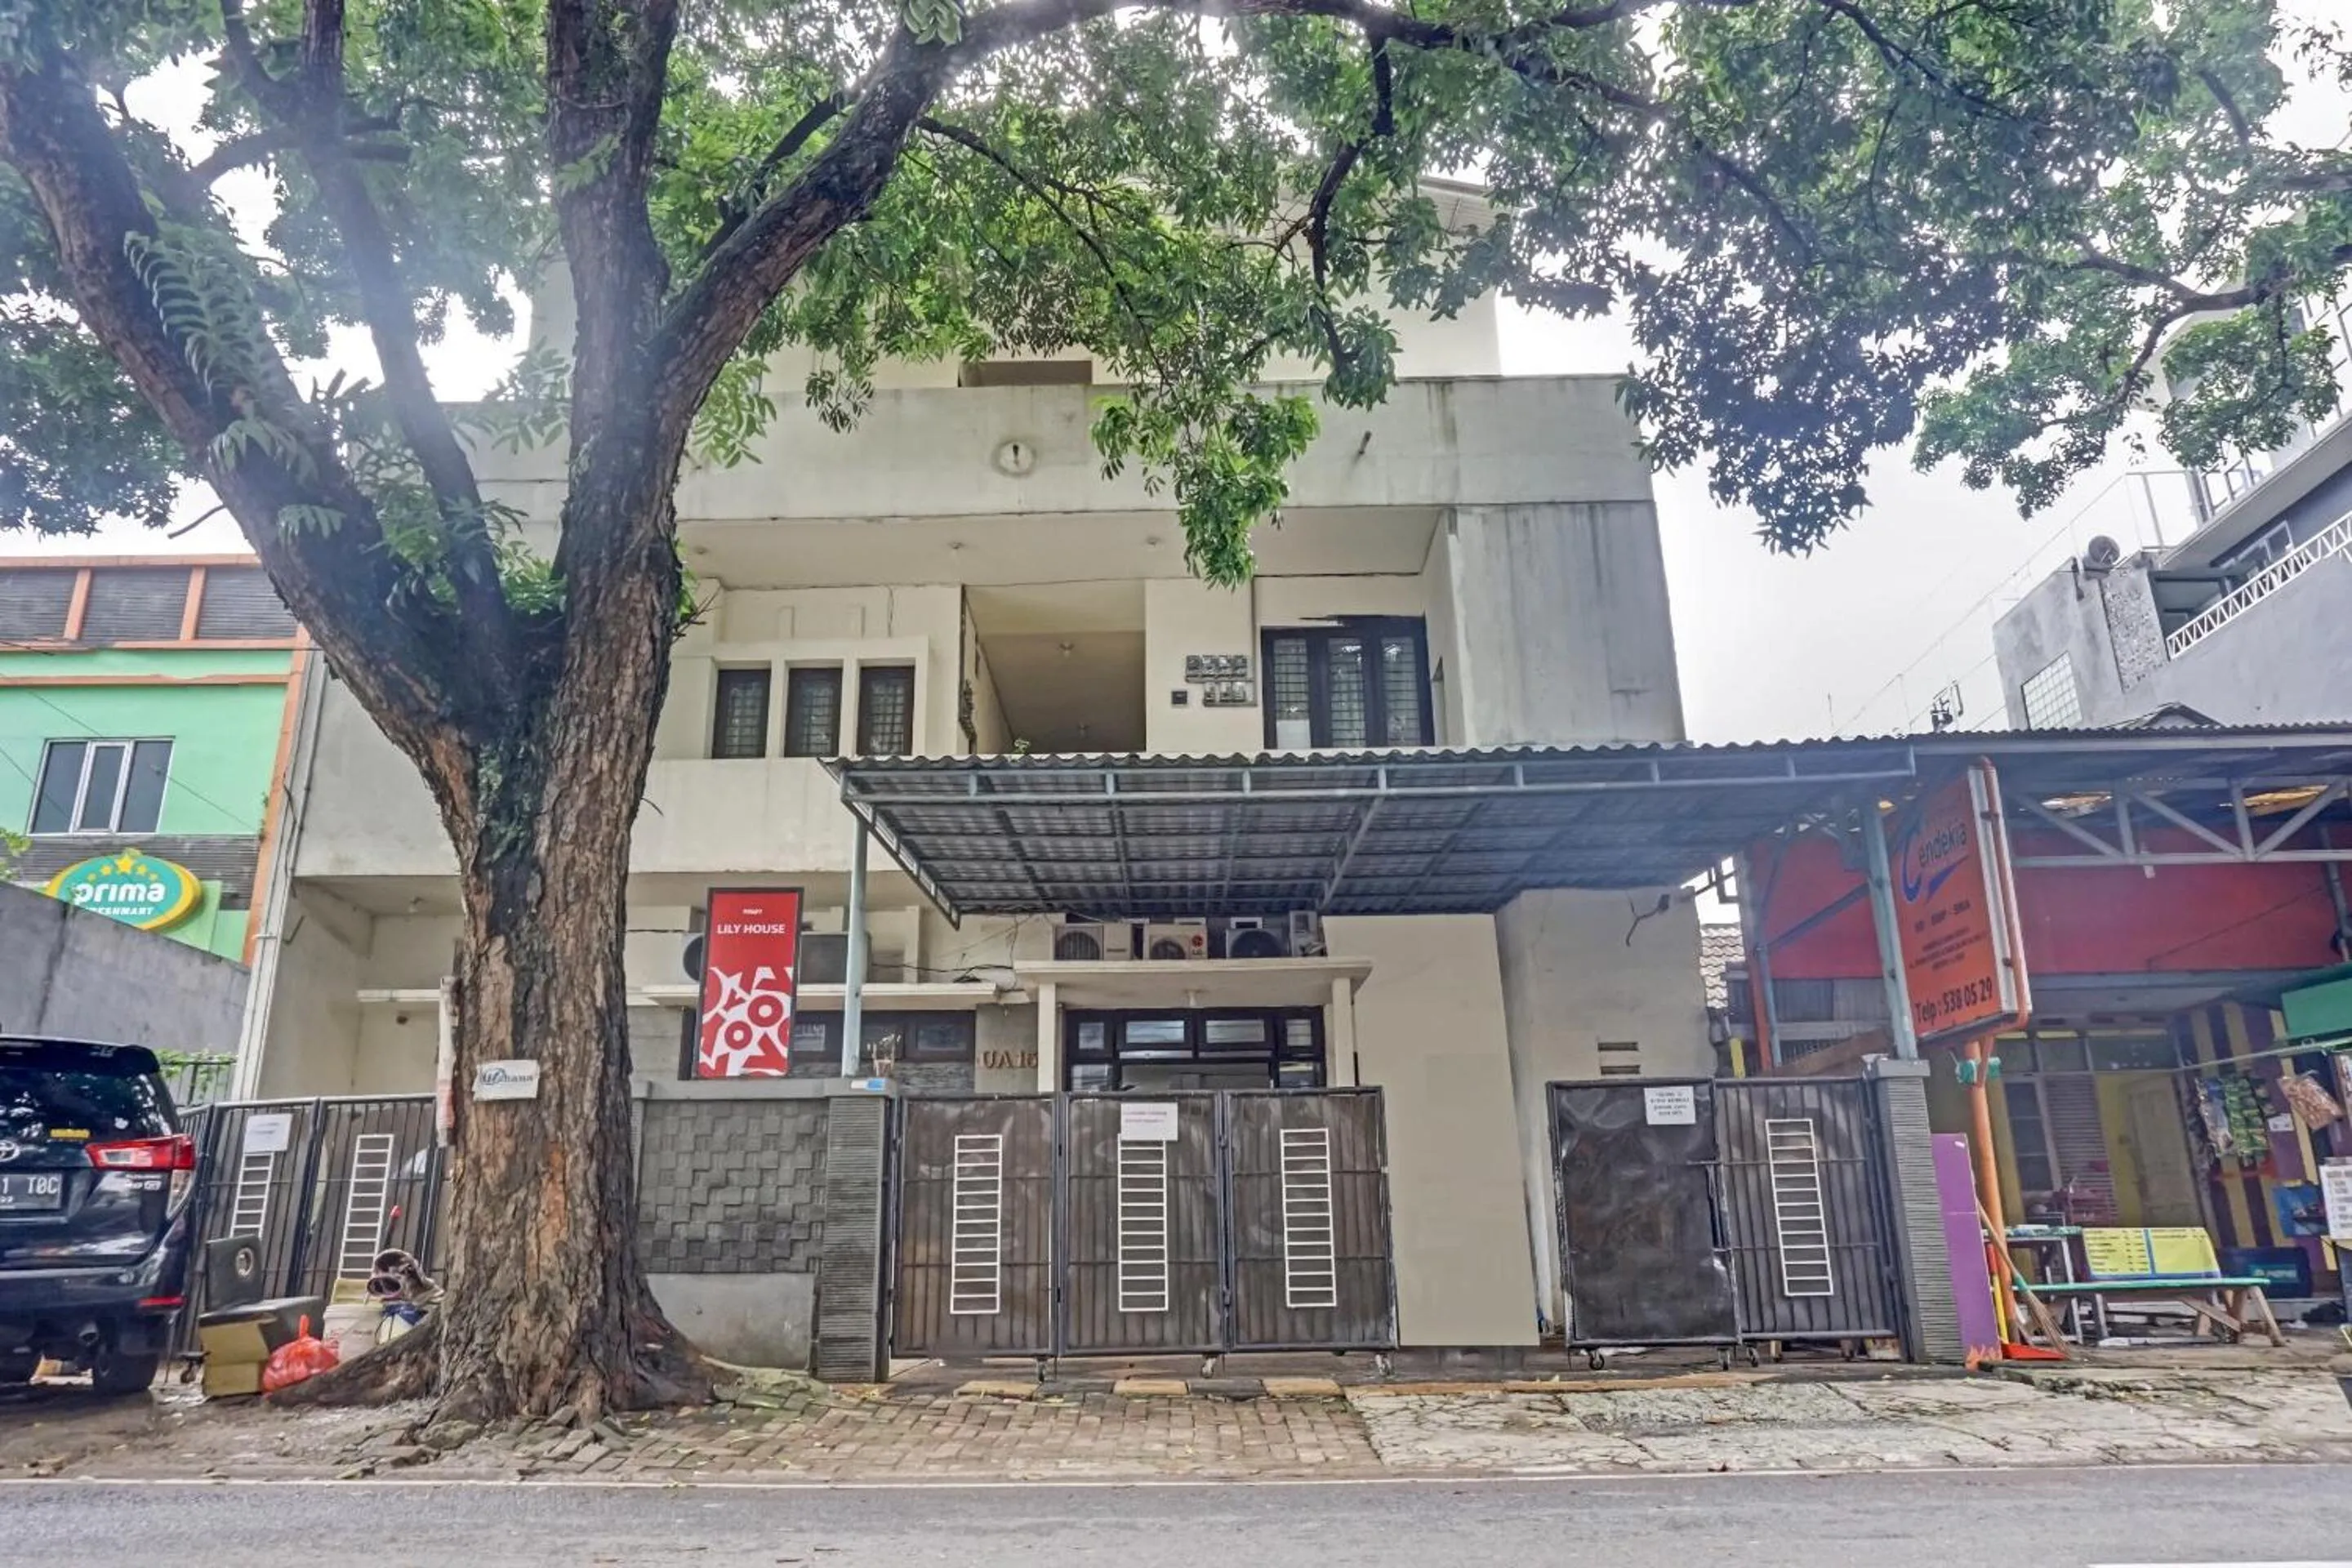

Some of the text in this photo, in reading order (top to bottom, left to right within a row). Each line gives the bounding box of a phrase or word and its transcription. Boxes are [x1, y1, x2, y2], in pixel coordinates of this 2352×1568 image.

[73, 883, 167, 906] prima
[718, 924, 786, 934] LILY HOUSE
[1979, 975, 1993, 1002] 29
